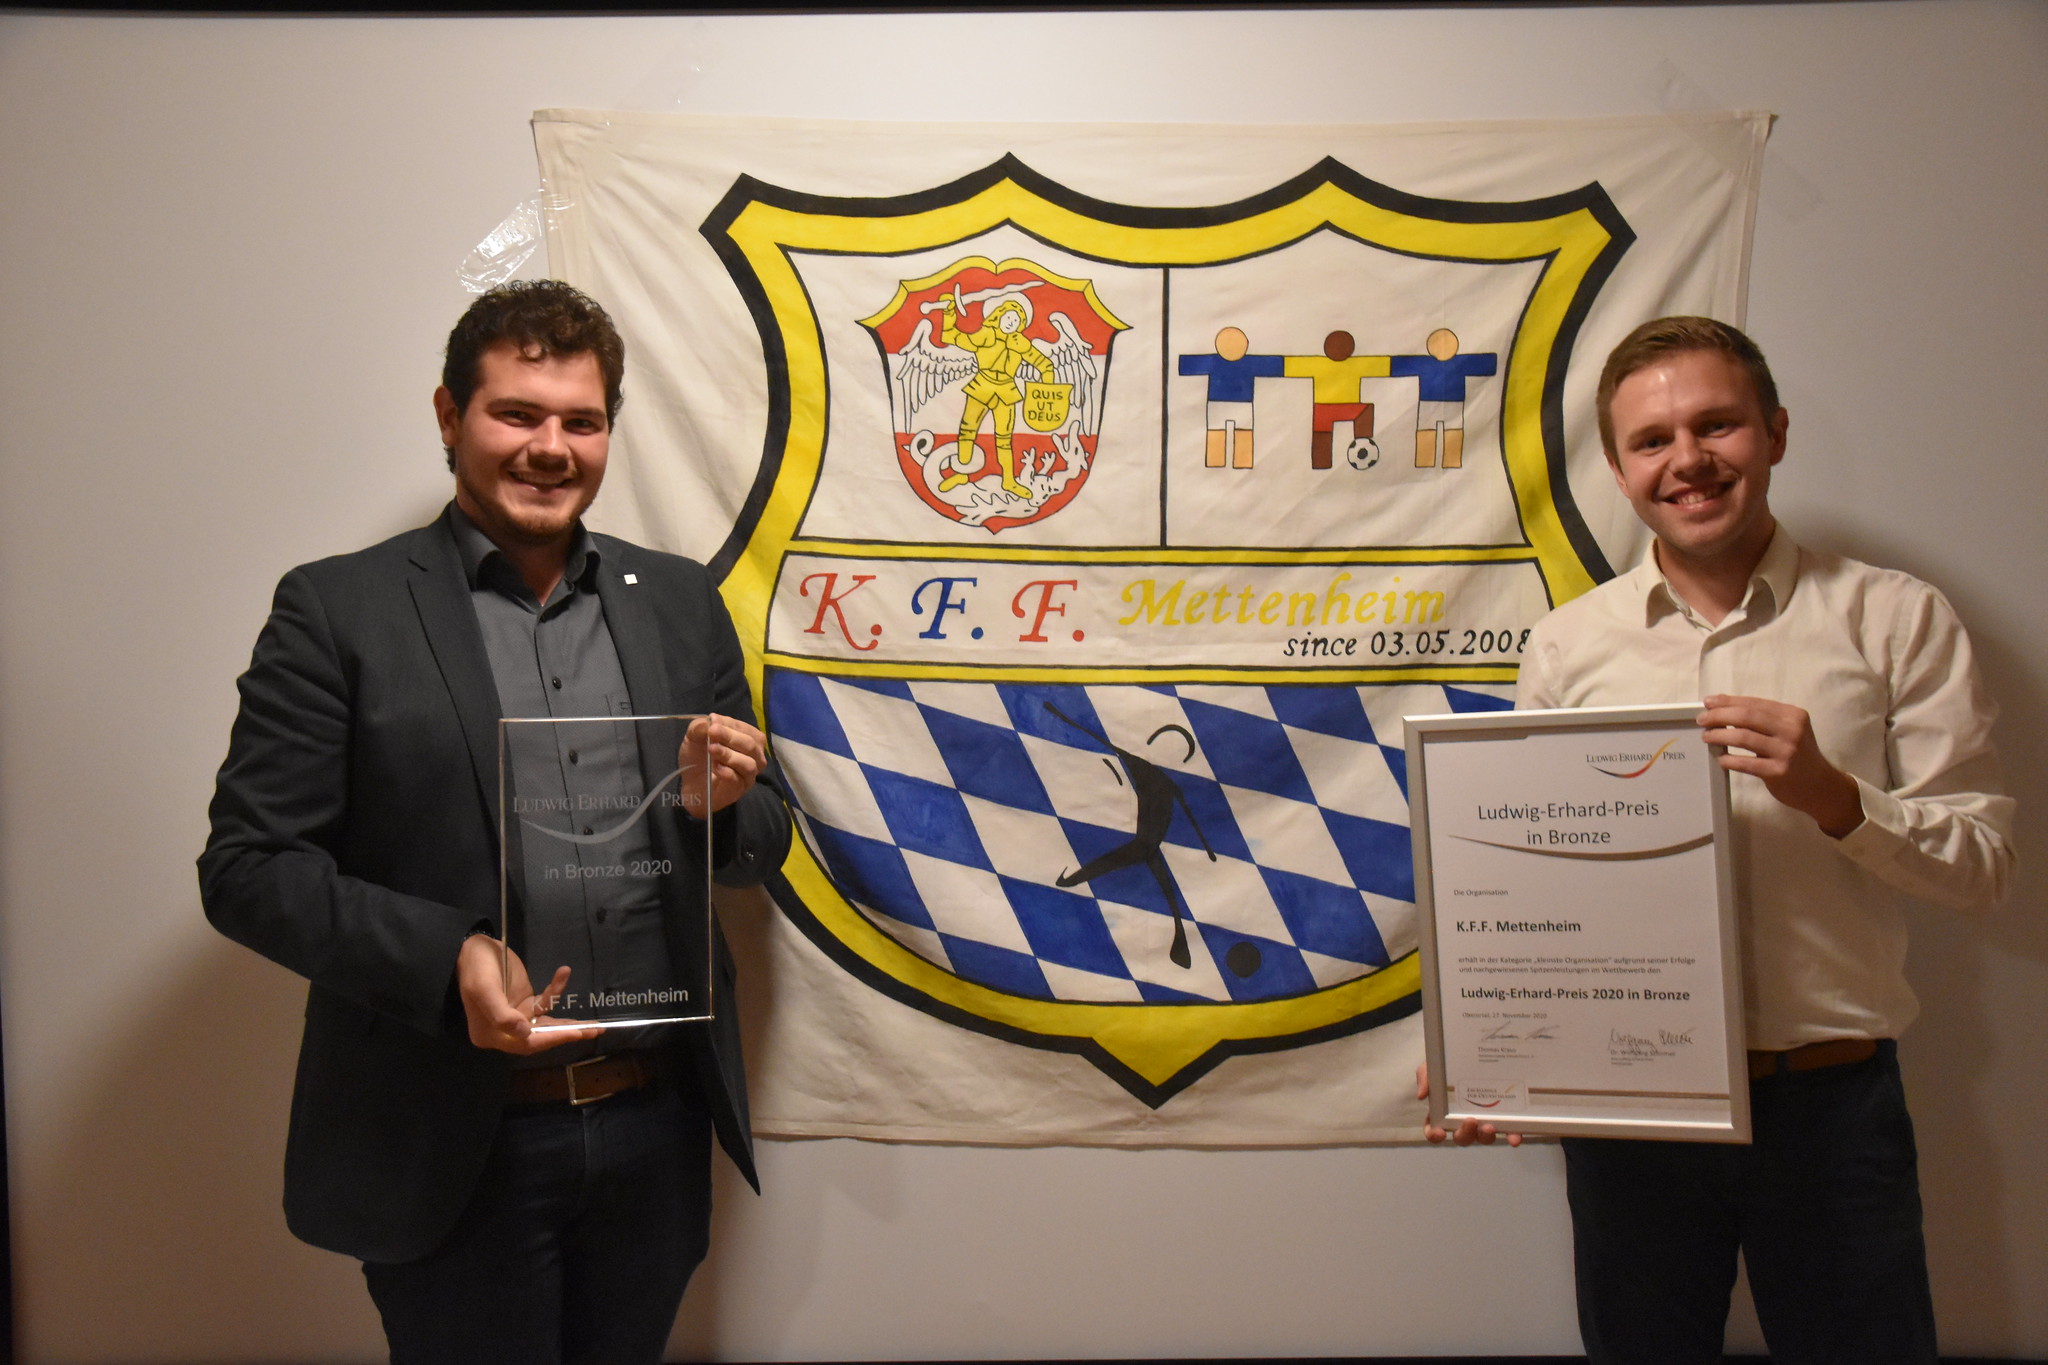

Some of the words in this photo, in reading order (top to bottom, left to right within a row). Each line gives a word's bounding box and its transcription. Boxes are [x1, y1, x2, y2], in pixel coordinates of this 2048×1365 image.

[1032, 389, 1063, 400] QUIS
[1037, 401, 1053, 411] UT
[1028, 410, 1061, 422] DEUS
[800, 572, 882, 650] K.
[911, 577, 984, 640] F.
[1012, 579, 1085, 642] F.
[1118, 572, 1445, 626] Mettenheim
[1283, 632, 1358, 656] since
[1370, 628, 1531, 657] 03.05.2008
[1477, 800, 1660, 822] Ludwig-Erhard-Preis
[1526, 830, 1543, 845] in
[1549, 829, 1611, 845] Bronze
[544, 865, 559, 880] in
[565, 863, 626, 879] Bronze
[630, 859, 672, 876] 2020
[1466, 889, 1509, 897] Organisation
[1456, 921, 1492, 932] K.F.F.
[1496, 920, 1581, 932] Mettenheim
[1500, 957, 1532, 965] Kategorie
[1613, 957, 1646, 966] aufgrund
[1670, 957, 1696, 966] Erfolge
[531, 993, 584, 1012] K.F.F.
[589, 987, 689, 1009] Mettenheim
[1461, 987, 1589, 1001] Ludwig-Erhard-Preis
[1592, 988, 1624, 1000] 2020
[1628, 988, 1640, 1000] in
[1644, 988, 1690, 1001] Bronze
